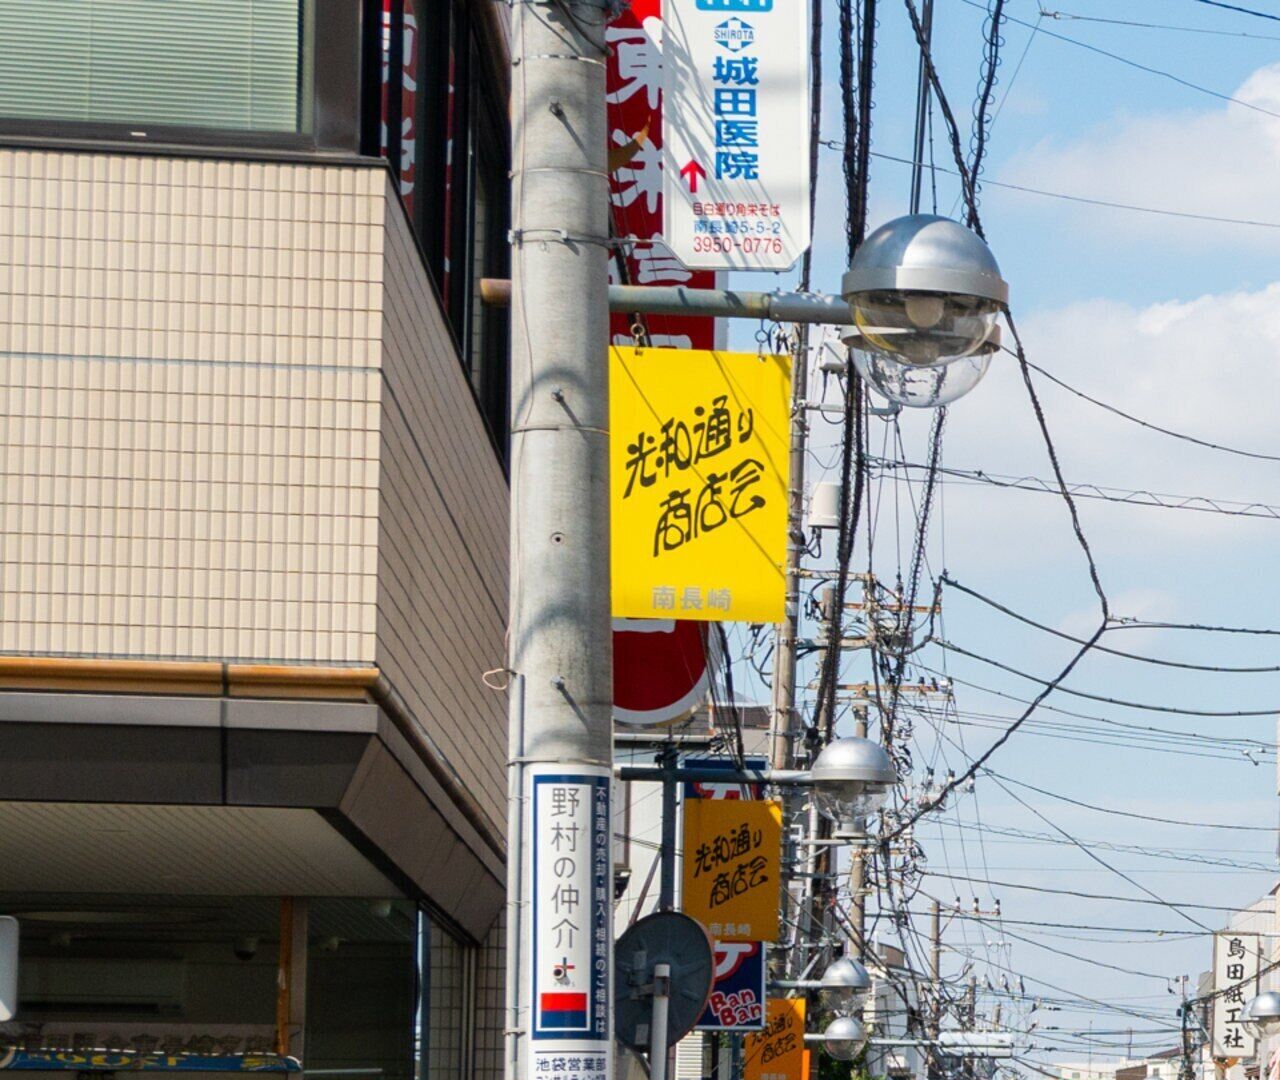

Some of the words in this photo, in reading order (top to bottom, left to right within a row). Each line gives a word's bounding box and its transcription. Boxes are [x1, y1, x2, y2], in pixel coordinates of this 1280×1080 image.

[714, 29, 755, 40] SHIROTA
[712, 56, 760, 181] 城田医院
[693, 236, 782, 254] 3950-0776
[623, 395, 753, 499] 光和通り
[653, 458, 767, 558] 商店会
[652, 586, 733, 612] 南長崎
[551, 787, 580, 949] 野村の仲介
[710, 856, 769, 909] 商店会
[709, 989, 756, 1016] Ban
[1223, 938, 1246, 1048] 島田紙工社
[719, 1003, 763, 1027] Ban
[536, 1058, 606, 1071] 池袋営業部
